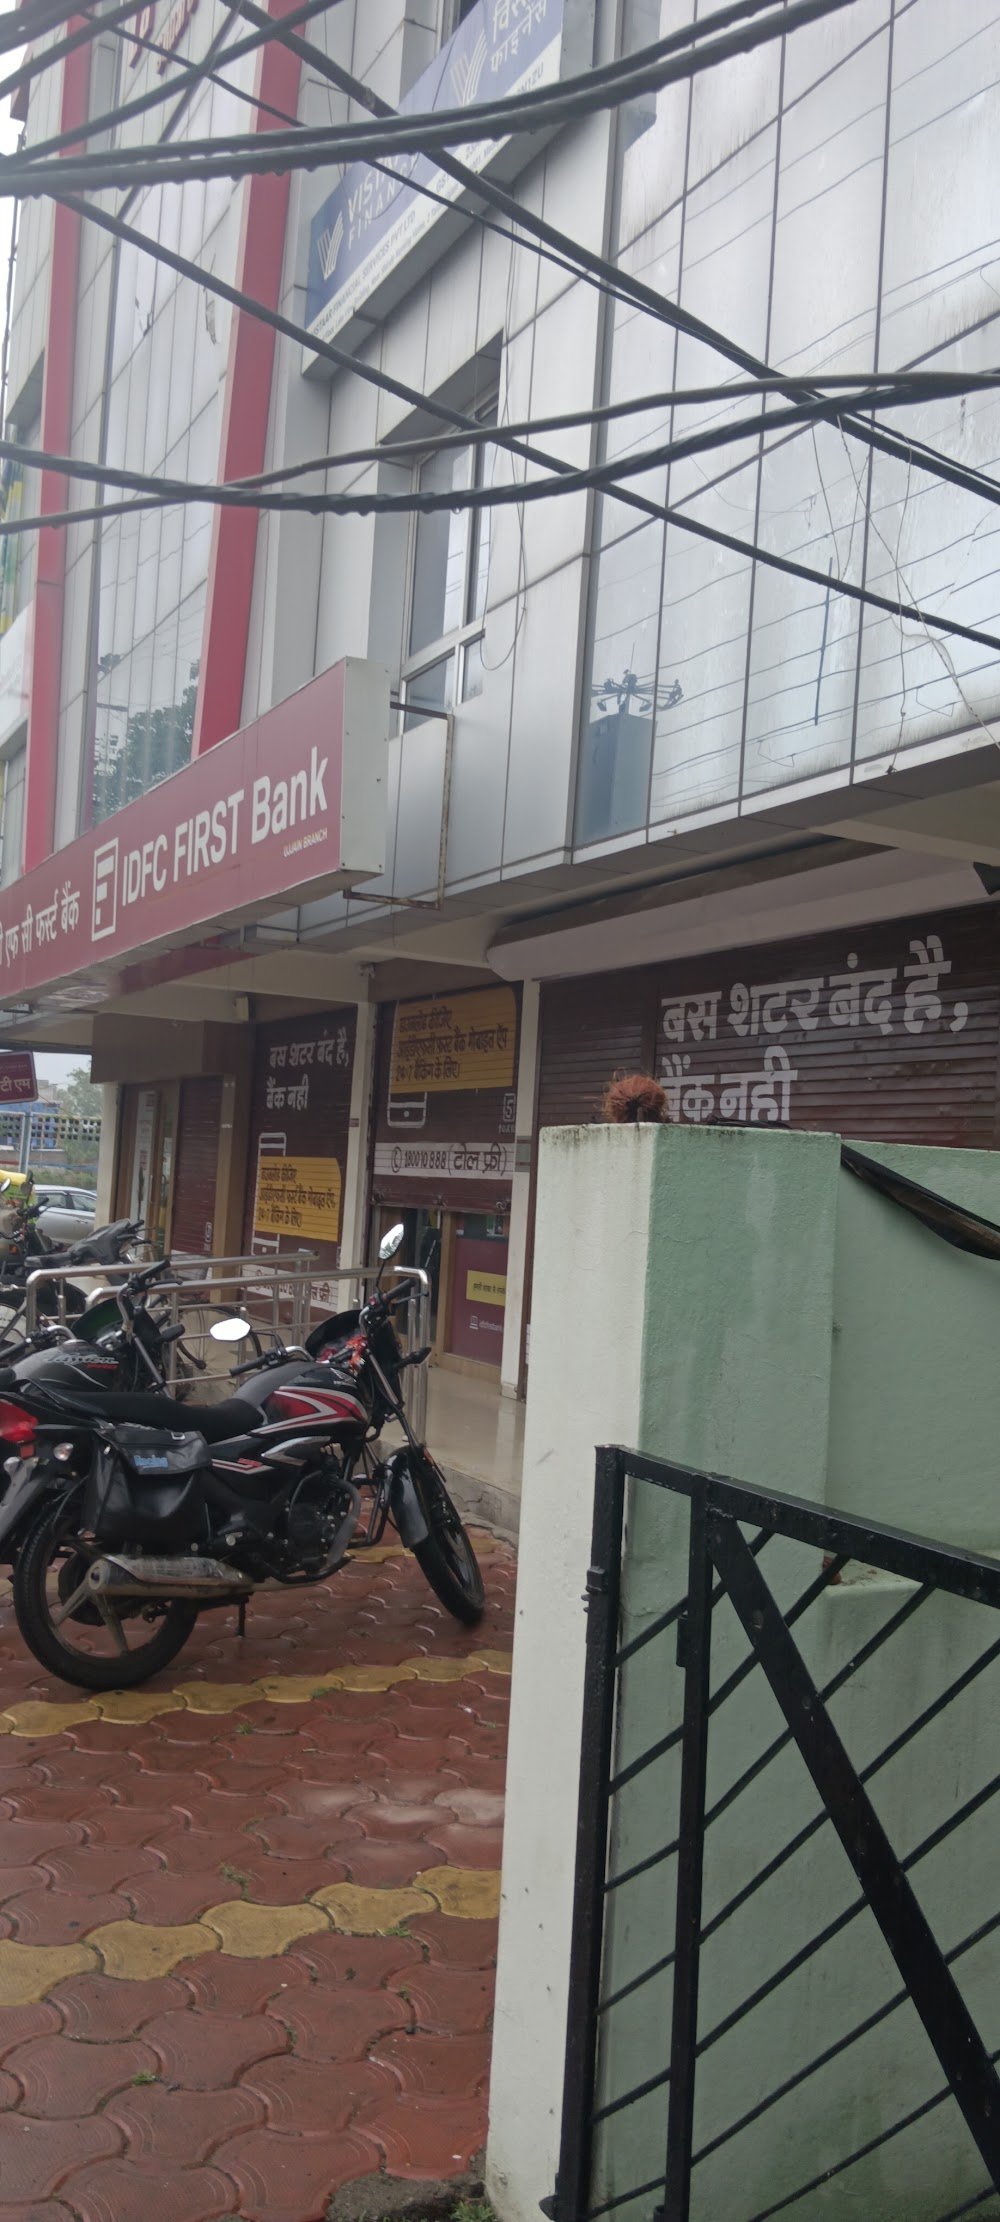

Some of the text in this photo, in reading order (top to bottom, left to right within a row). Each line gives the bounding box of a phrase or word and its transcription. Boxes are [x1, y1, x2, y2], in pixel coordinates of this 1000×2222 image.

[122, 746, 329, 906] IDFC FIRST Bank
[21, 903, 33, 954] सी
[61, 880, 80, 934] बैंक
[661, 991, 722, 1042] बस
[727, 977, 825, 1037] शटर
[828, 953, 898, 1035] बंद
[289, 1042, 316, 1066] शटर
[317, 1029, 336, 1066] बंद
[266, 1075, 287, 1109] बैंक
[660, 1054, 715, 1122] बैंक
